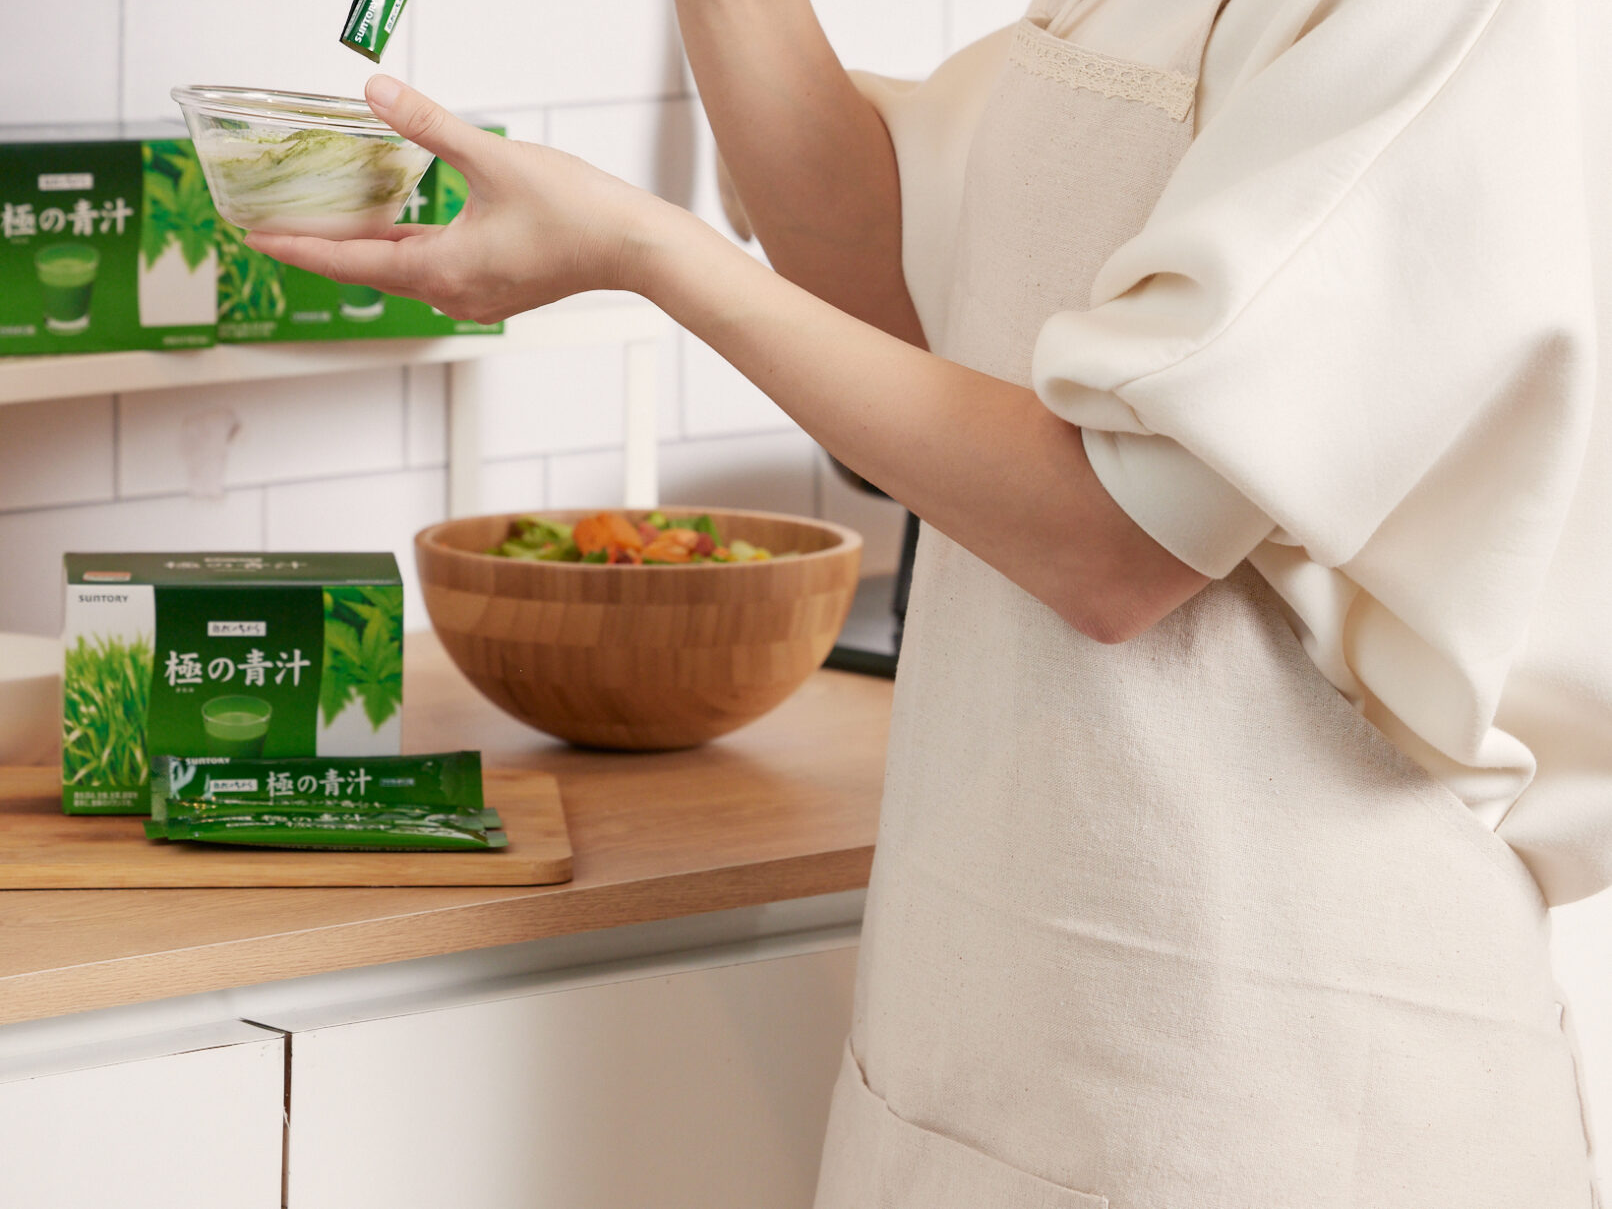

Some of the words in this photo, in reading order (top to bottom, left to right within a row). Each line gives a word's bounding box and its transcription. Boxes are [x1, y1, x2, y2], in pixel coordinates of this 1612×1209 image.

[1, 197, 134, 238] 極の青汁
[78, 595, 128, 603] SUNTORY
[164, 649, 311, 687] 極の青汁
[266, 767, 372, 797] 極の青汁
